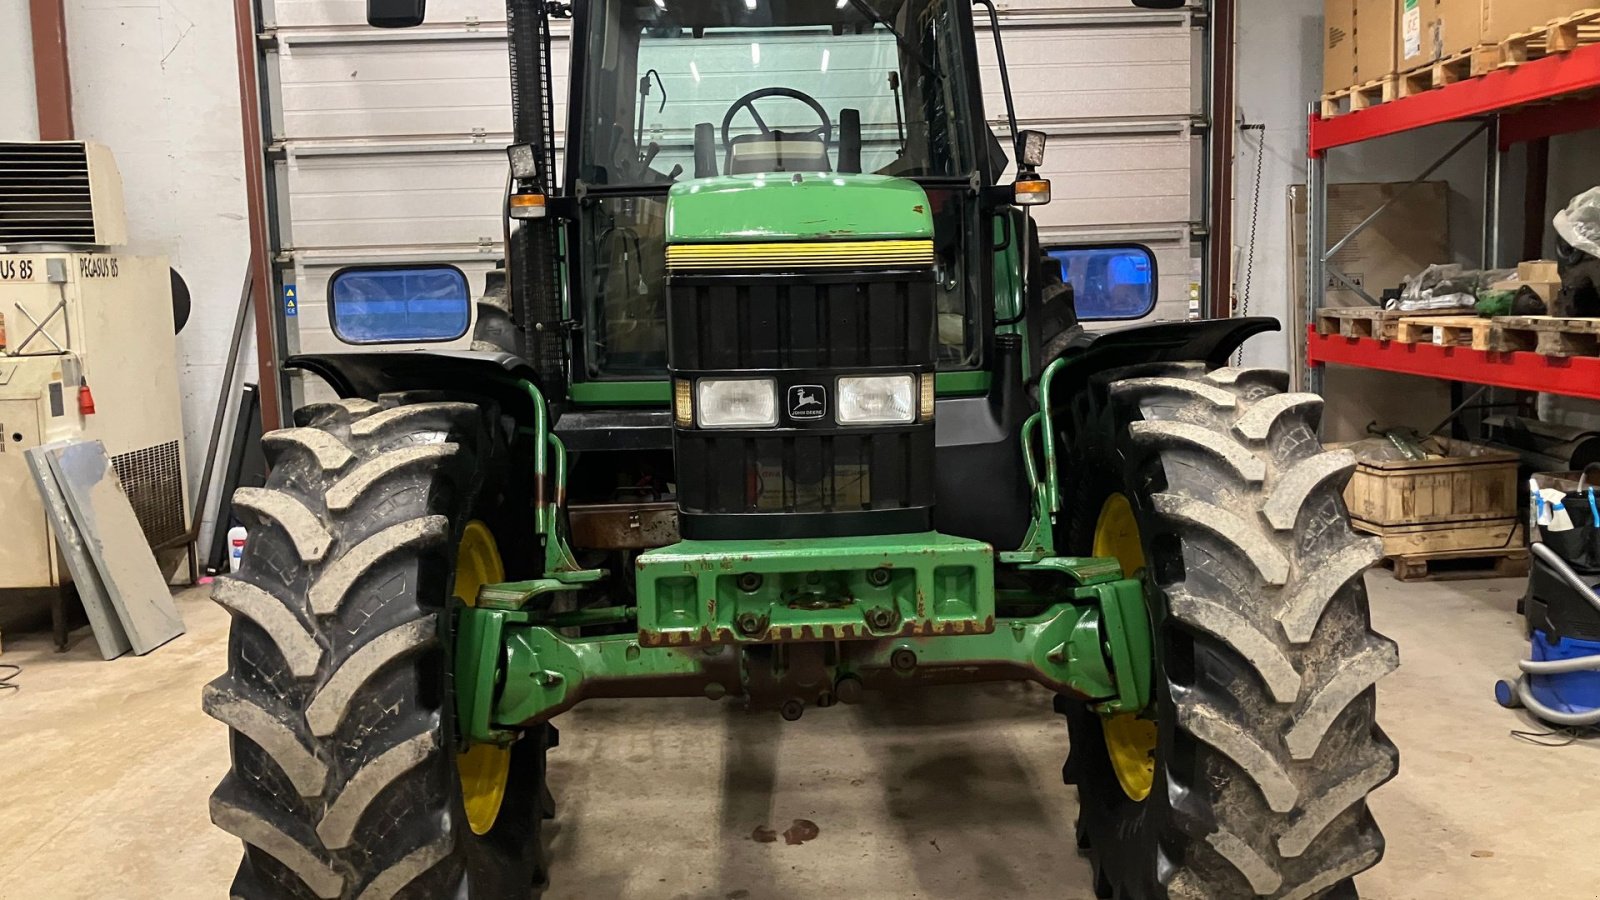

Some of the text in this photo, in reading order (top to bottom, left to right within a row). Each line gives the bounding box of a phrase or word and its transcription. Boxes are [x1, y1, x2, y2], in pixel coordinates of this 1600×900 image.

[20, 260, 33, 279] 85
[80, 258, 119, 277] PEGASUS 85
